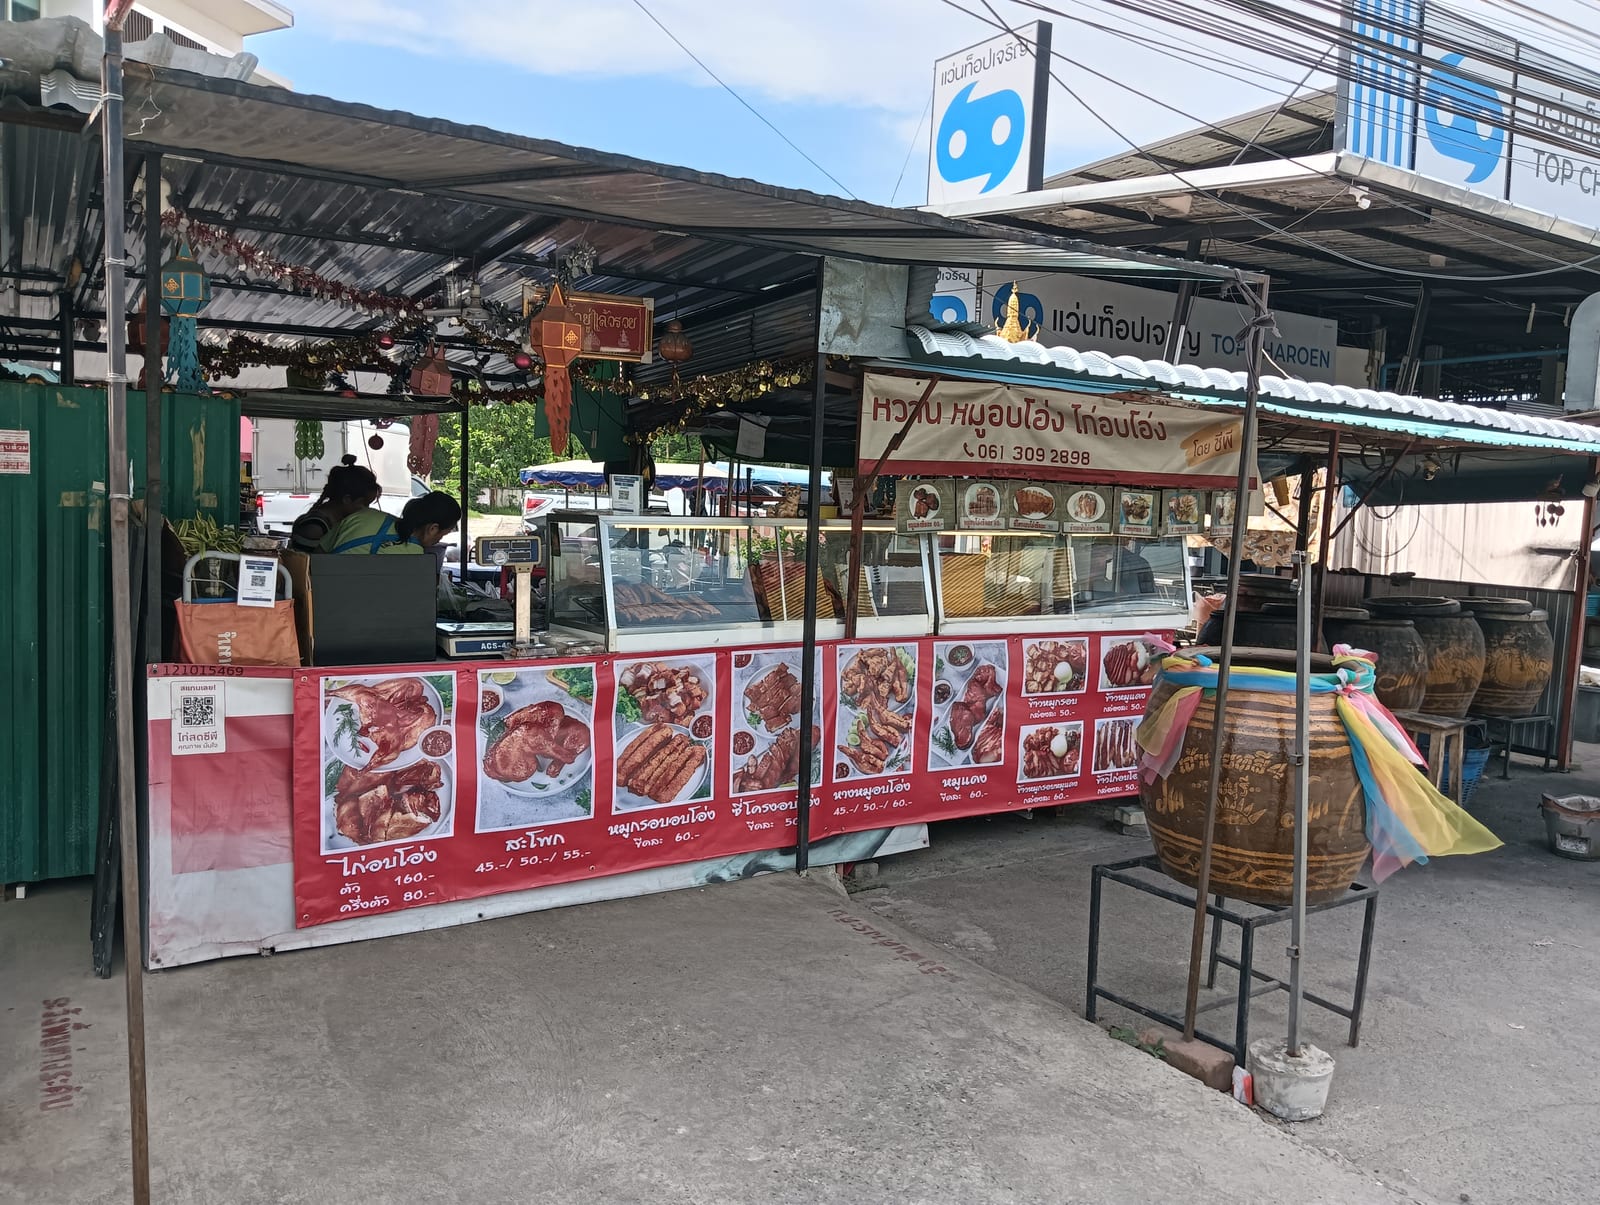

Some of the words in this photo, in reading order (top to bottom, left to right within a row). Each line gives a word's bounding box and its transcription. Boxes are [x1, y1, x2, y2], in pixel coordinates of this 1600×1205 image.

[940, 40, 1029, 86] แว่นท็อปเจริญ
[1533, 149, 1574, 186] TOP
[1052, 301, 1201, 358] แว่นท็อปเจญ
[1262, 342, 1330, 369] HAROEN
[872, 396, 942, 425] หวาน
[950, 397, 1065, 439] หมูอบโอ่ง
[1071, 403, 1168, 441] ไก่อบโอ่ง
[977, 443, 1005, 460] 061
[1012, 446, 1046, 463] 309
[1049, 449, 1091, 466] 2898
[1192, 438, 1211, 458] โดย
[162, 664, 245, 677] 121015469
[180, 684, 217, 692] สแกนเลย!
[1105, 692, 1146, 704] ข้าวหมูแดง
[1028, 697, 1078, 710] ข้าวหมูกรอบ
[1029, 710, 1057, 719] กล่องละ
[1059, 709, 1076, 717] 50.-
[1103, 704, 1129, 713] กล่องละ
[1130, 703, 1145, 711] 50.-
[832, 778, 912, 801] หางหมูอบโอ่ง
[942, 774, 988, 791] หมูแดง
[1097, 785, 1123, 795] กล่องละ
[731, 793, 821, 817] ซี่โครงอบ่ง
[892, 799, 913, 808] 60.-
[940, 792, 962, 802] ขีดละ
[969, 790, 988, 799] 60.-
[1023, 795, 1051, 804] กล่องละ
[1053, 792, 1070, 801] 60.-
[607, 805, 717, 839] หมูกรอบอบโอ่ง
[746, 820, 775, 832] ขีดละ
[505, 829, 566, 852] สะโพก
[633, 837, 664, 849] ขีดละ
[675, 831, 701, 842] 60.-
[325, 845, 438, 877] ไก่อบโอ่ง
[475, 857, 514, 873] 45.-/
[519, 851, 557, 867] 50.-/
[563, 849, 592, 861] 55.-
[340, 882, 361, 895] ตัว
[394, 872, 436, 886] 160.-
[340, 895, 390, 913] ครึ่งตัว
[403, 889, 436, 902] 80.-
